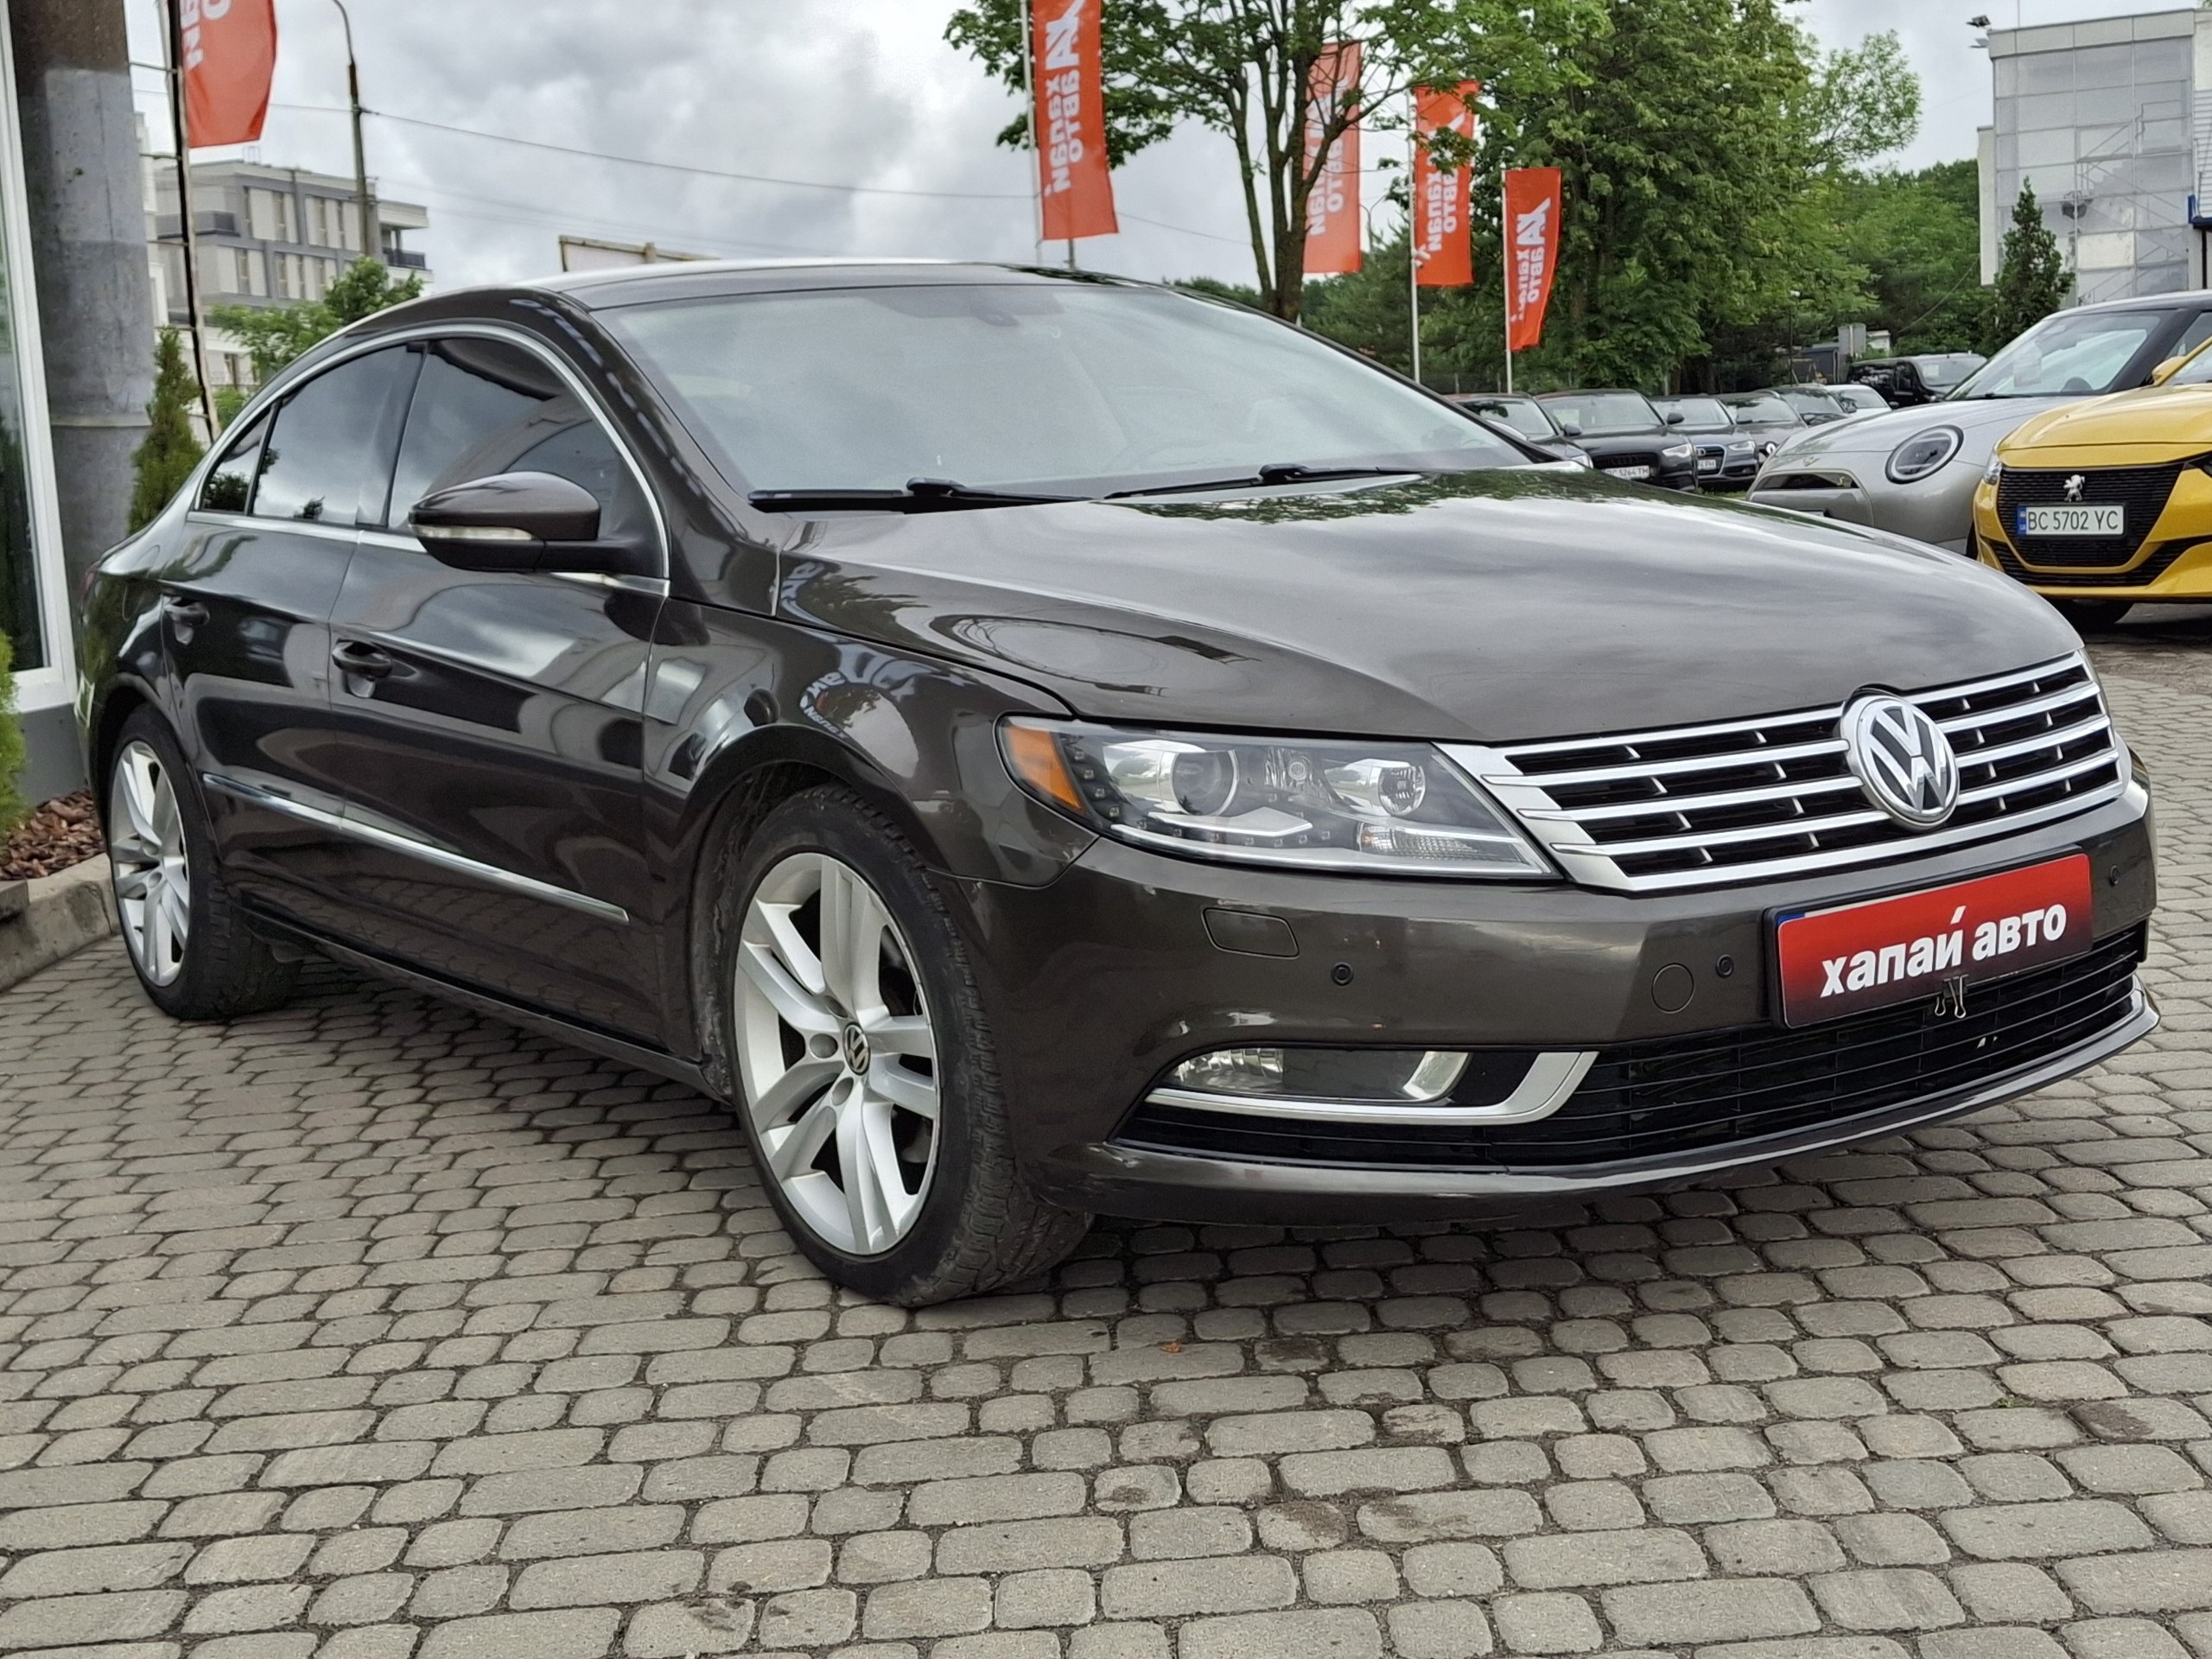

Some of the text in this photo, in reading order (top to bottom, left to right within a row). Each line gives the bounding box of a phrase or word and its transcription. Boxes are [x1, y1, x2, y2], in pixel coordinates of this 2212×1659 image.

[2028, 511, 2118, 531] BC 5702 YC
[1821, 904, 2067, 998] хапай авто
